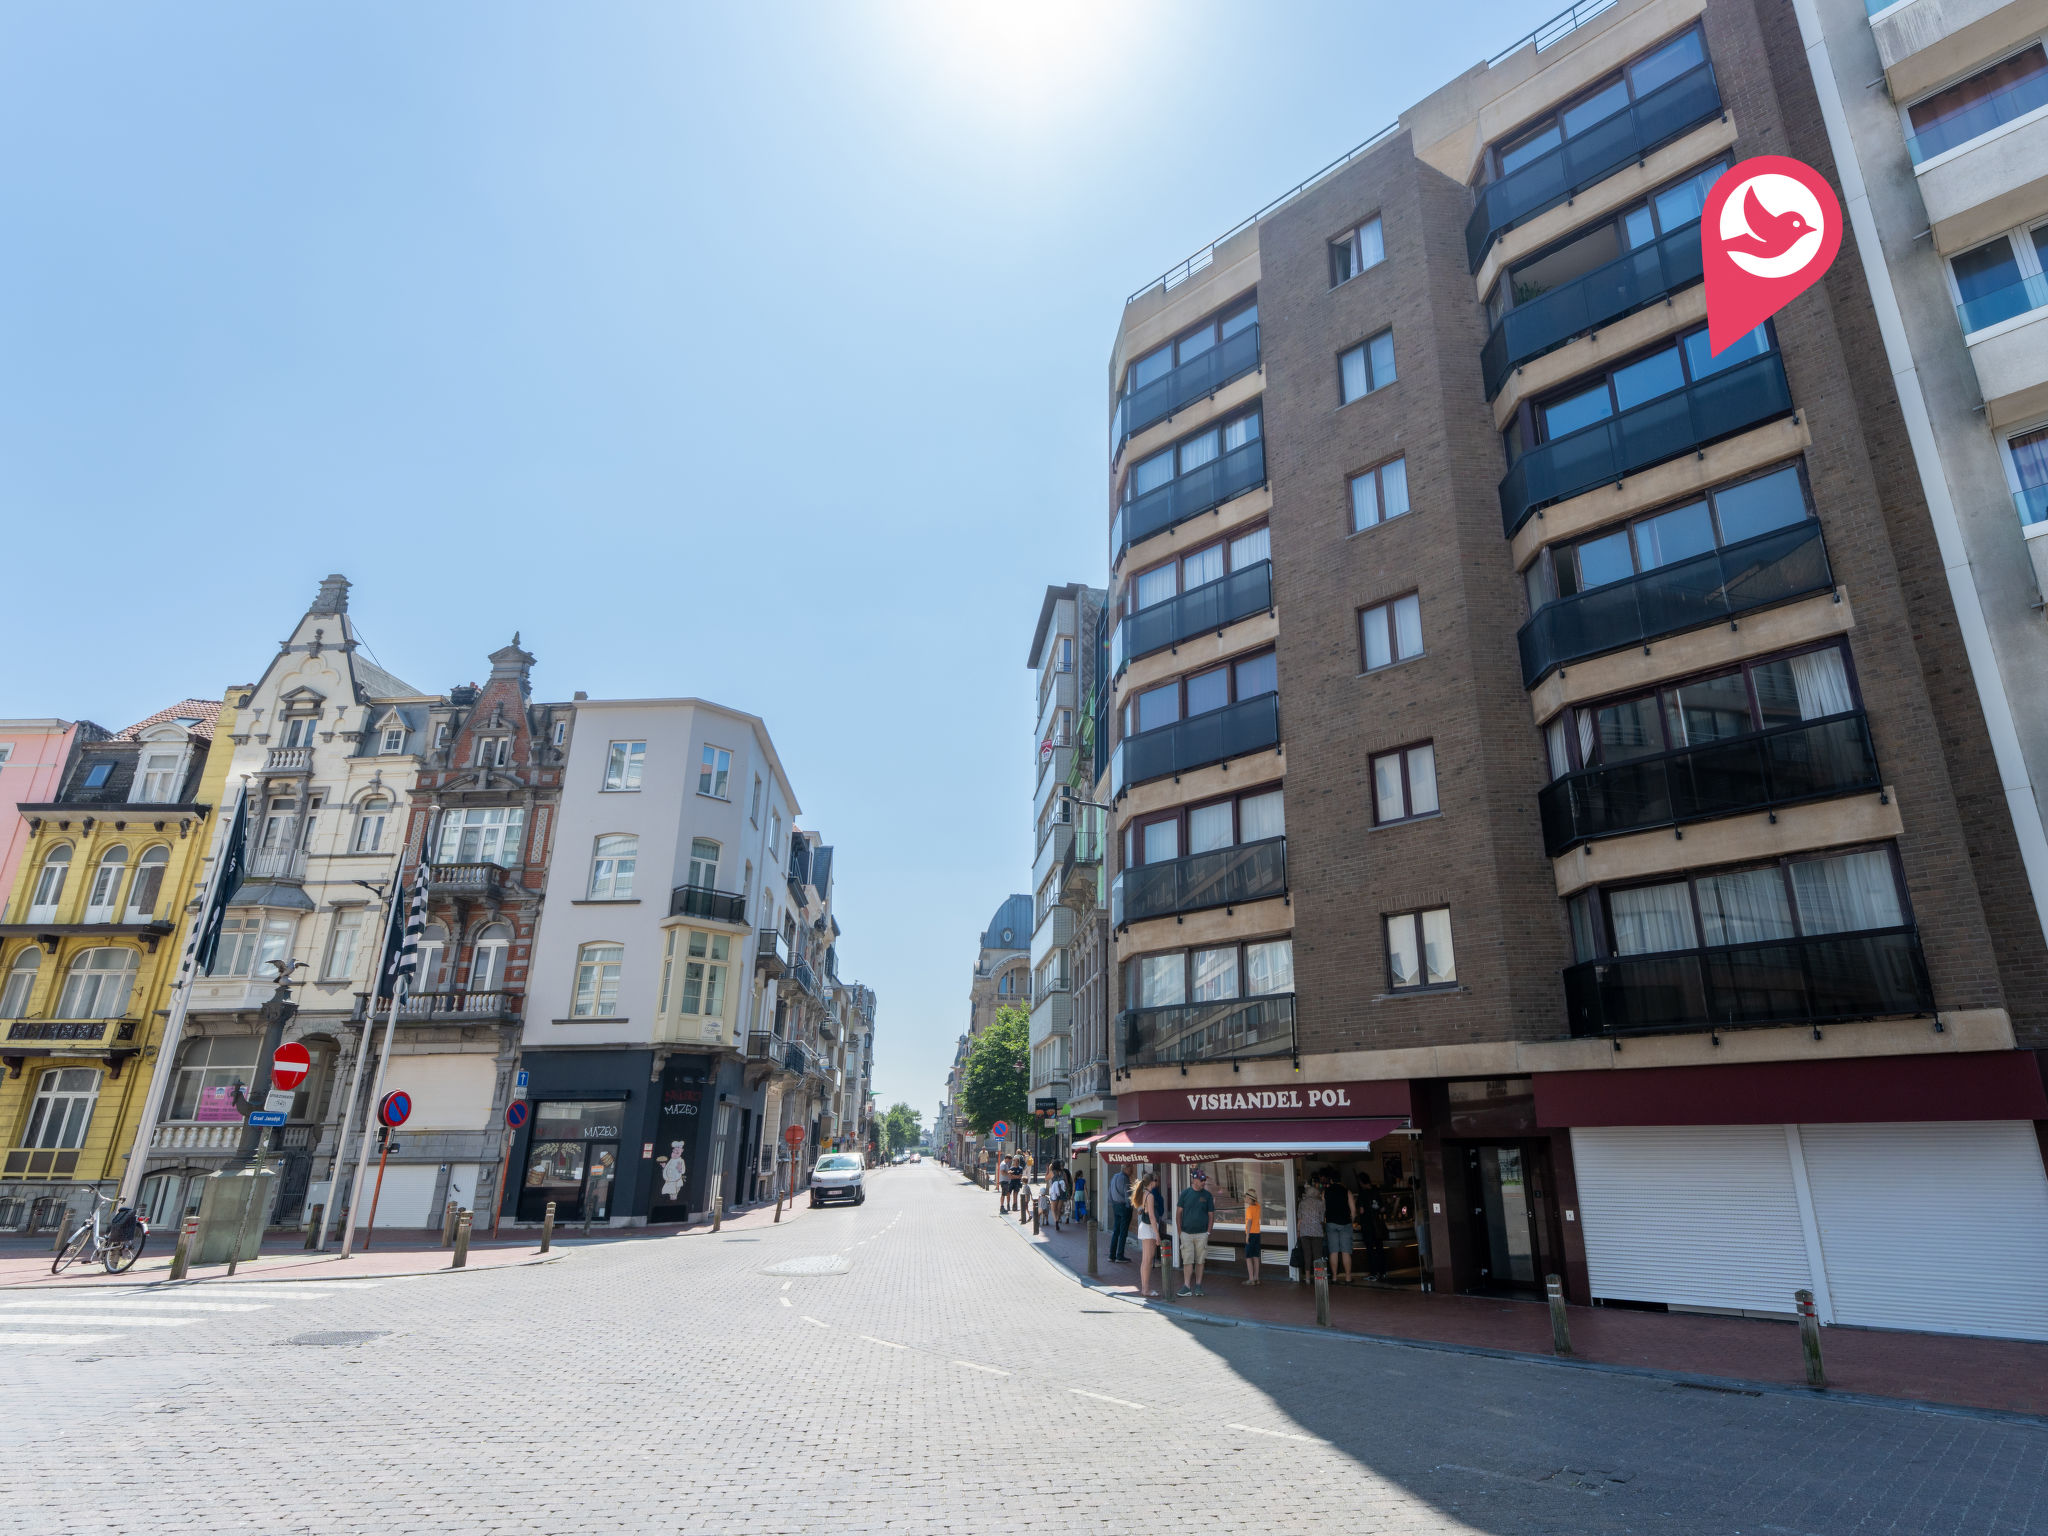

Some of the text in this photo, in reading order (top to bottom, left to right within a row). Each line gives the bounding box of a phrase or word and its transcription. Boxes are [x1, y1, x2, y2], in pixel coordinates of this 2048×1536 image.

[1187, 1089, 1351, 1111] VISHANDEL POL
[664, 1103, 698, 1116] MAZEO
[583, 1125, 618, 1138] MAZEO
[1108, 1153, 1149, 1163] Kibbeling
[1179, 1153, 1219, 1162] Traiteur
